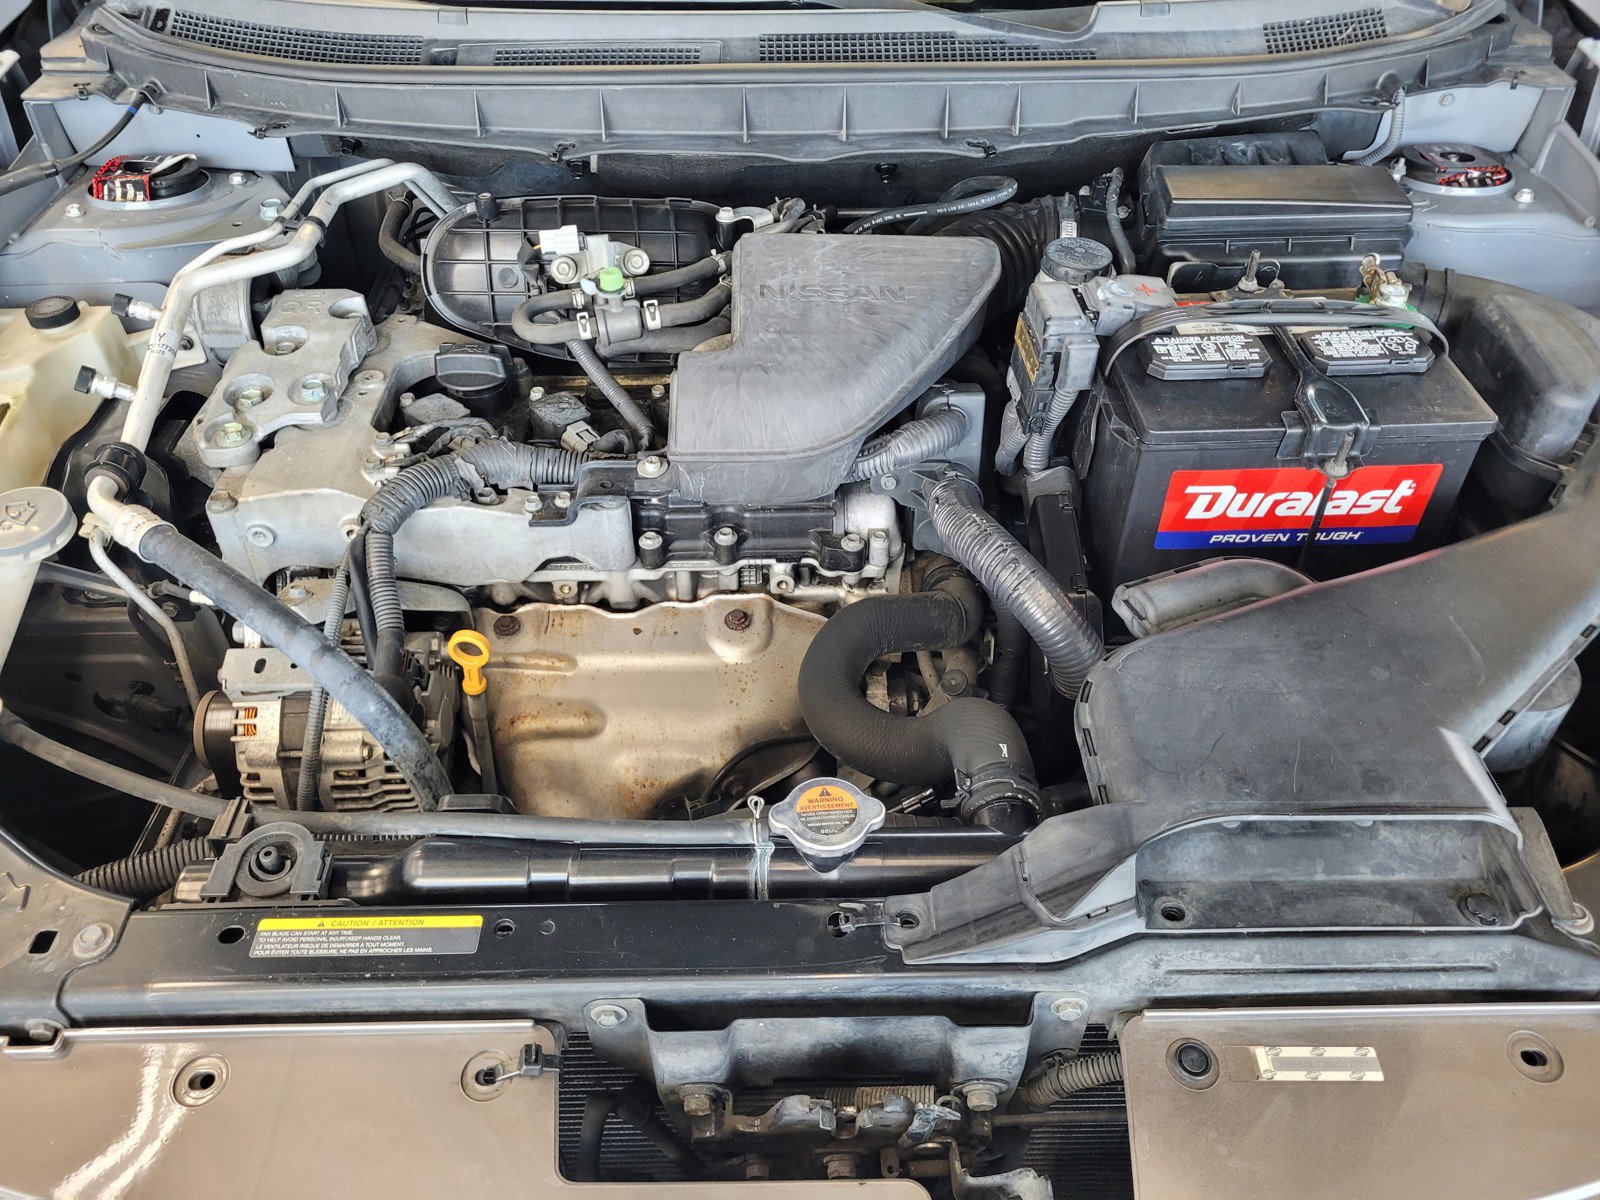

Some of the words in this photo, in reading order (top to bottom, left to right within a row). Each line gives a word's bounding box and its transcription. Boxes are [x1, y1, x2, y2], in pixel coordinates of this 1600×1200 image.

[759, 284, 906, 302] NISSAN
[1184, 480, 1415, 520] Duralast
[1208, 532, 1291, 544] PROVEN
[1296, 531, 1363, 541] TUGH
[800, 802, 854, 811] AVERTISSEMENT
